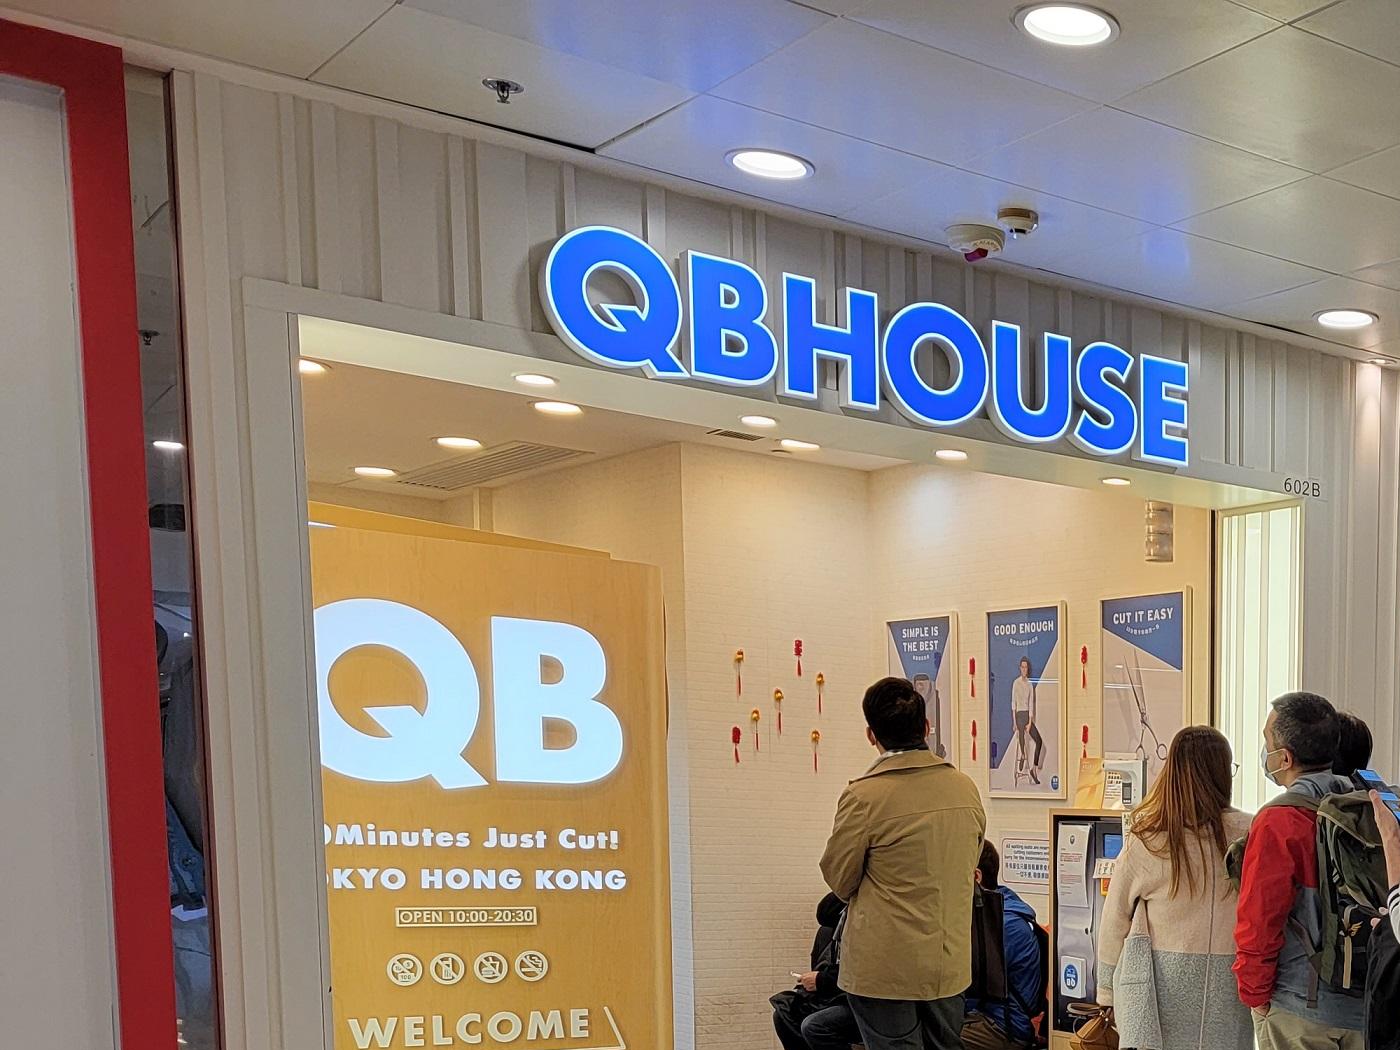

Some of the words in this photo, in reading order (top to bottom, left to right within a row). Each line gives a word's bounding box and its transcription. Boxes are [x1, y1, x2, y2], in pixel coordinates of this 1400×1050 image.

[1284, 477, 1321, 497] 602B
[1113, 611, 1132, 625] CUT
[1135, 610, 1145, 623] IT
[1147, 607, 1174, 622] EASY
[902, 626, 929, 639] SIMPLE
[931, 625, 939, 637] IS
[994, 624, 1017, 636] GOOD
[1019, 620, 1054, 634] ENOUGH
[902, 641, 918, 653] THE
[919, 640, 939, 651] BEST
[314, 598, 623, 790] QB
[324, 823, 471, 848] Minutes
[483, 827, 547, 849] Just
[558, 828, 619, 850] Cut!
[326, 868, 406, 890] KYO
[421, 868, 522, 890] HONG
[535, 869, 627, 890] KONG
[400, 911, 443, 923] OPEN
[447, 910, 533, 923] 10:00-20:30
[347, 1008, 590, 1049] WELCOME
